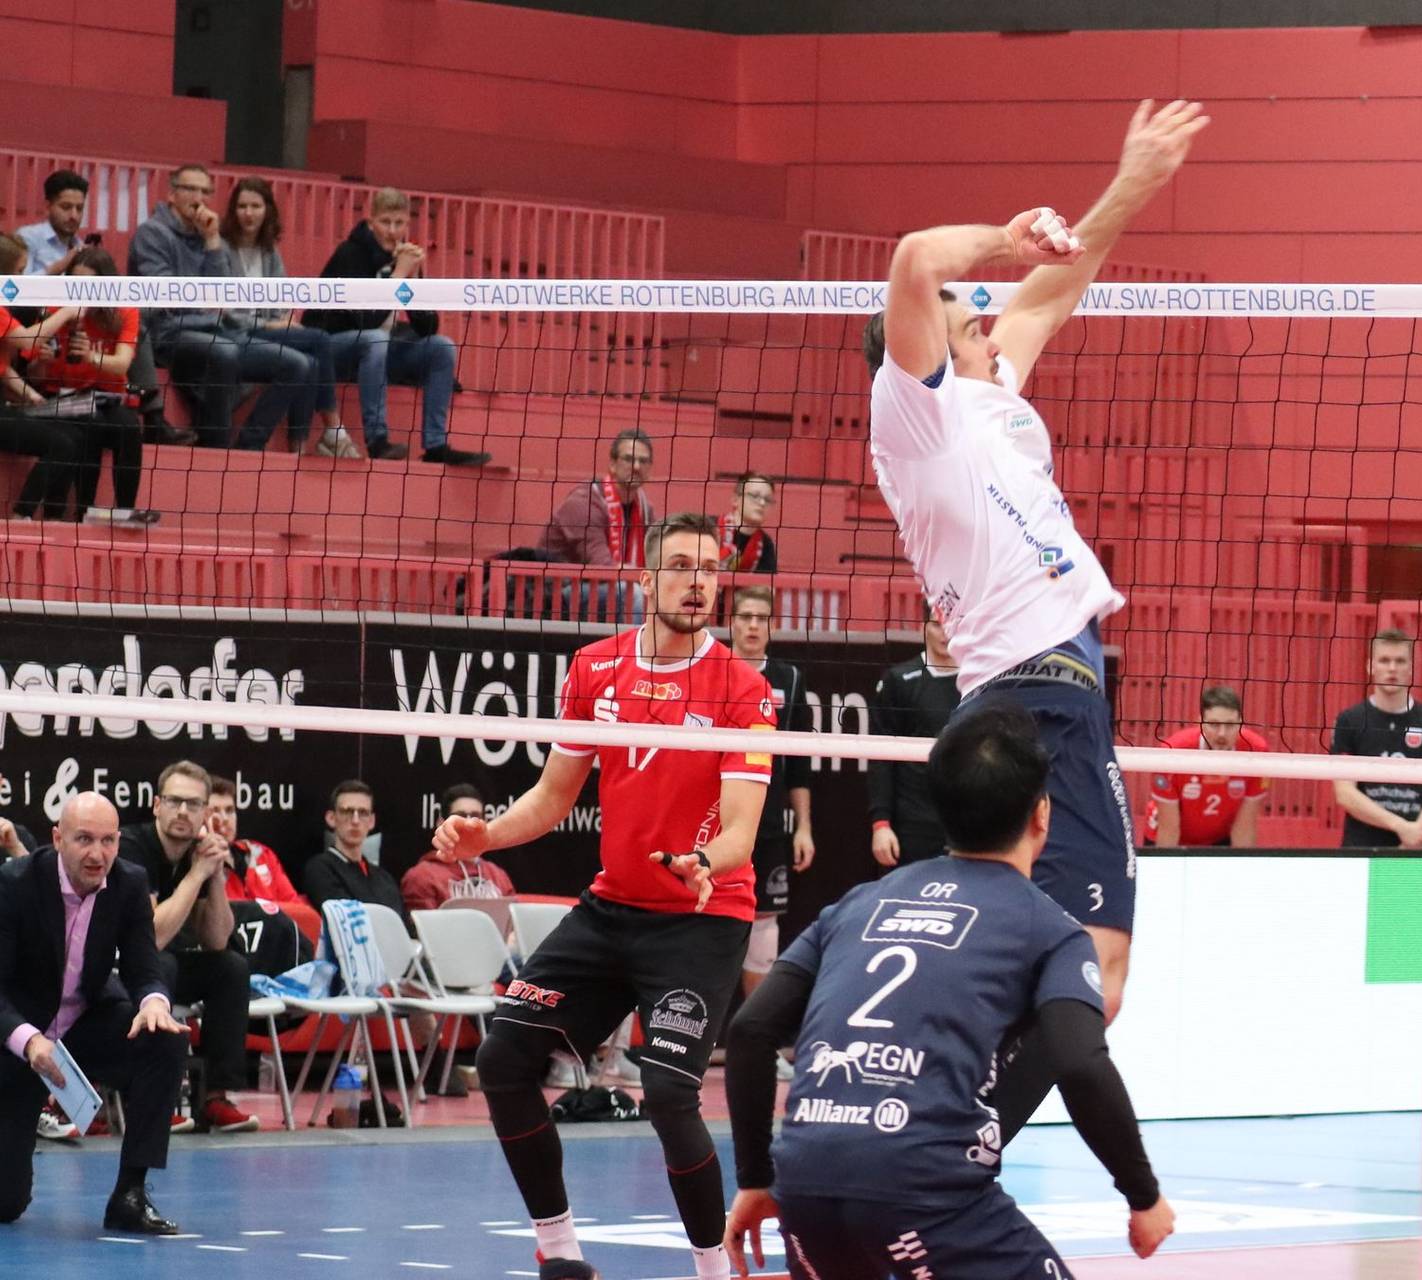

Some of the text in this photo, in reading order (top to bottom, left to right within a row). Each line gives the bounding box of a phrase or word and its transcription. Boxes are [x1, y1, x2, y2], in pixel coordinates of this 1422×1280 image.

[65, 281, 346, 304] WWW.SW-ROTTENBURG.DE
[463, 284, 885, 308] STADTWERKE ROTTENBURG AM NECK
[1078, 289, 1376, 311] W.SW-ROTTENBURG.DE
[1204, 794, 1221, 816] 2
[920, 882, 957, 898] OR
[1088, 883, 1104, 912] 3
[878, 918, 954, 935] SWD
[847, 946, 917, 1028] 2
[652, 1036, 687, 1055] Kempa
[865, 1042, 925, 1077] EGN
[793, 1097, 872, 1124] Allianz
